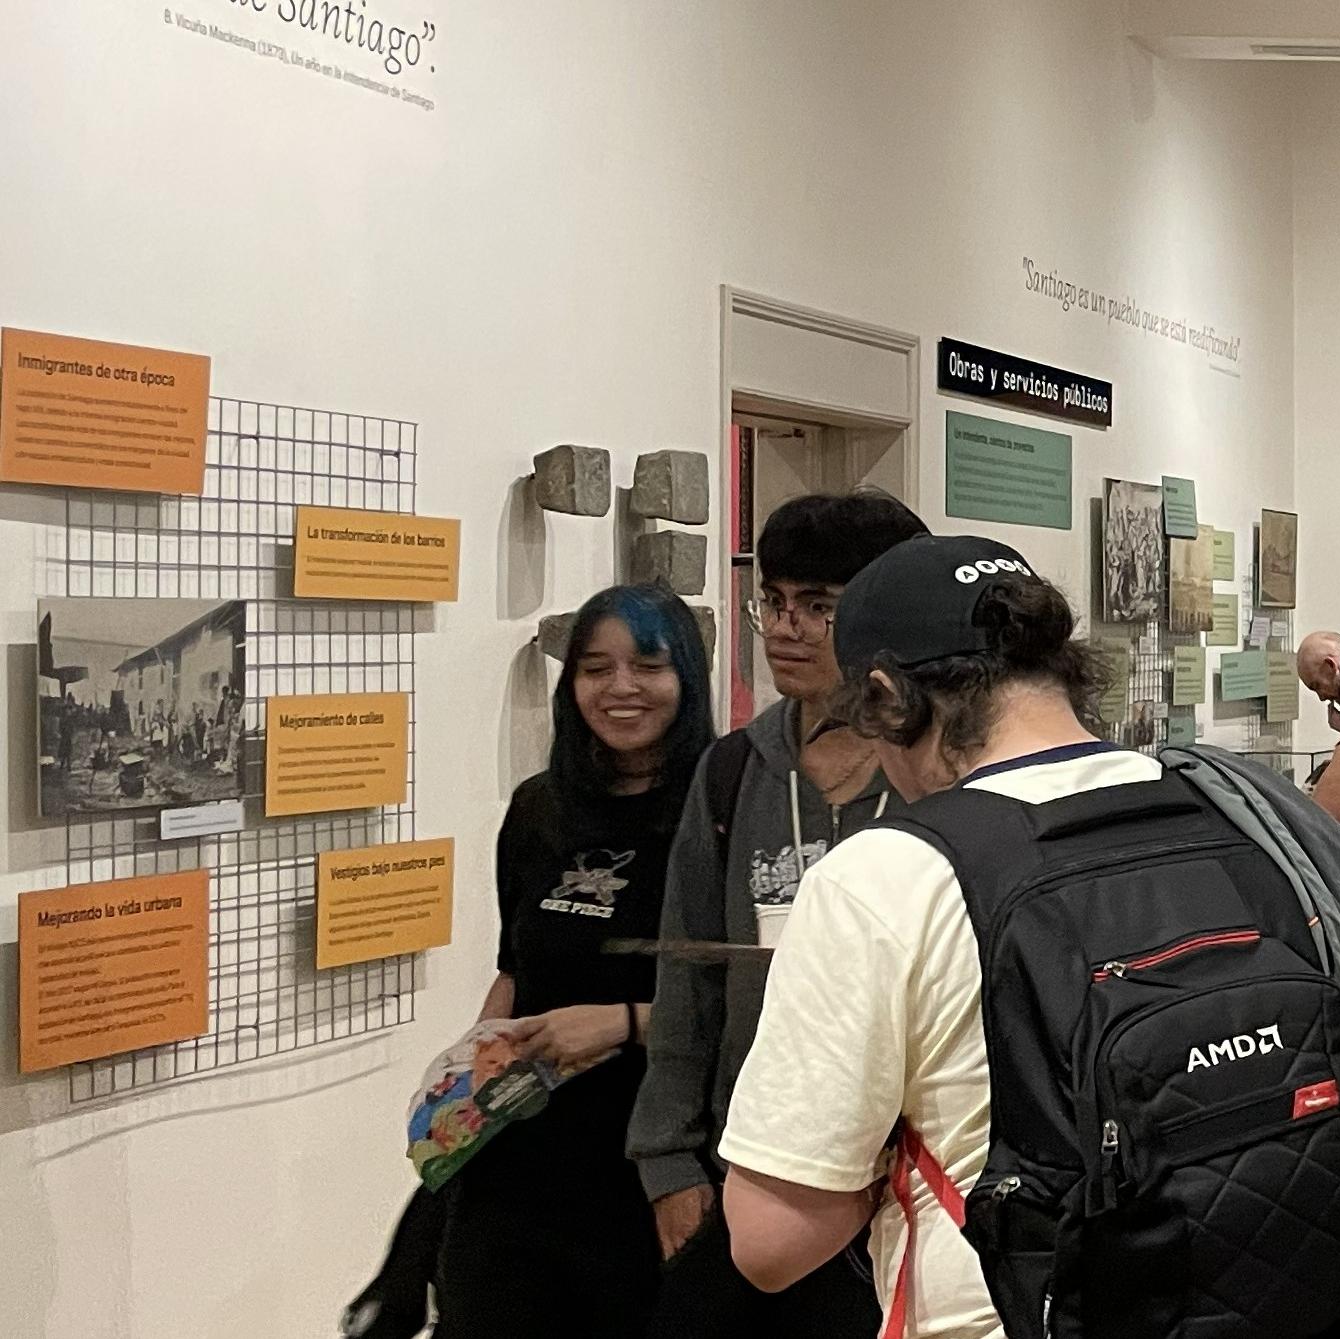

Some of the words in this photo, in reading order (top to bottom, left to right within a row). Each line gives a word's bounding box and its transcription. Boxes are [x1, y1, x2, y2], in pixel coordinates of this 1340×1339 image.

[17, 351, 93, 377] Inmigrantes
[95, 362, 111, 379] de
[113, 366, 138, 383] otra
[140, 365, 176, 388] época
[949, 350, 985, 384] Obras
[990, 367, 998, 391] y
[1003, 371, 1060, 402] servicios
[1063, 382, 1109, 414] públicos
[307, 526, 319, 539] La
[320, 527, 389, 545] transformación
[390, 531, 402, 545] de
[403, 533, 415, 546] los
[279, 711, 344, 731] Mejoramiento
[346, 711, 359, 726] de
[360, 711, 385, 726] calles
[37, 904, 103, 929] Mejorando
[104, 903, 115, 919] la
[117, 899, 142, 915] vida
[143, 895, 183, 913] urbana
[1186, 1033, 1257, 1074] AMD
